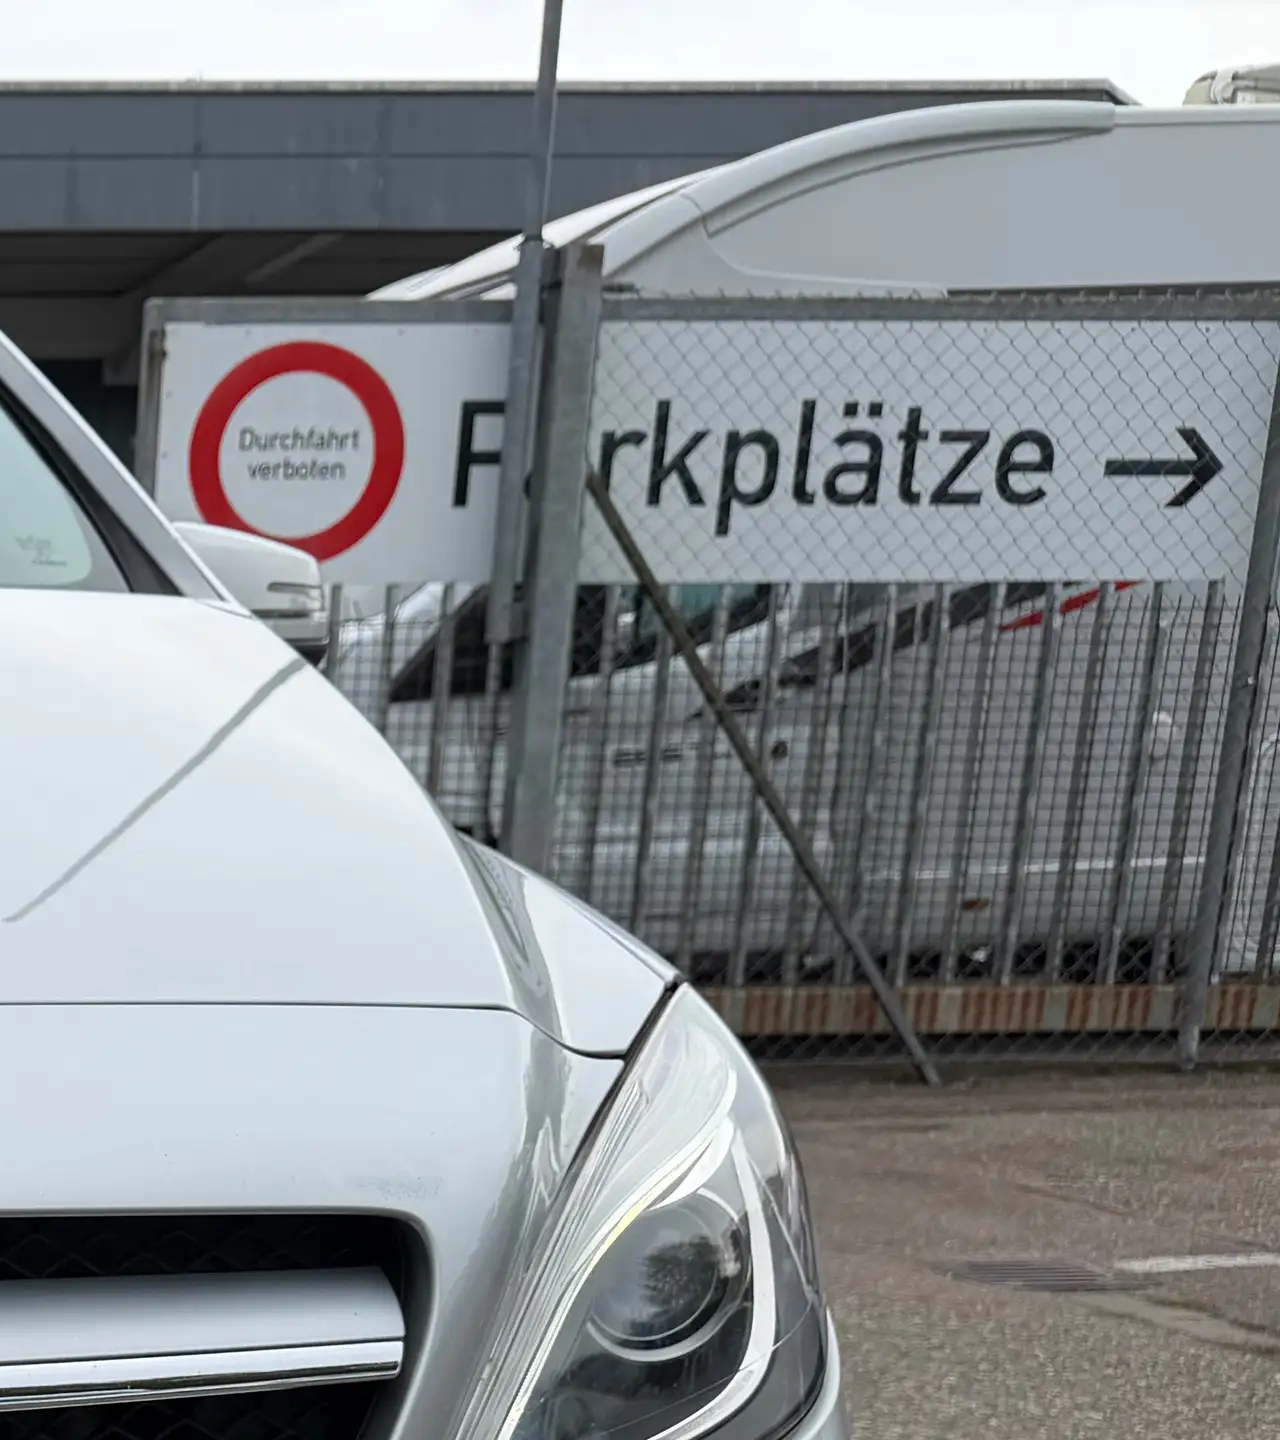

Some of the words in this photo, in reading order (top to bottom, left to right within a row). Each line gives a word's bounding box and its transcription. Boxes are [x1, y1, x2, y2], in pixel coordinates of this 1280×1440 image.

[238, 426, 359, 452] Durchfahrt
[247, 457, 346, 480] verboten
[451, 400, 1055, 536] Prkplätze
